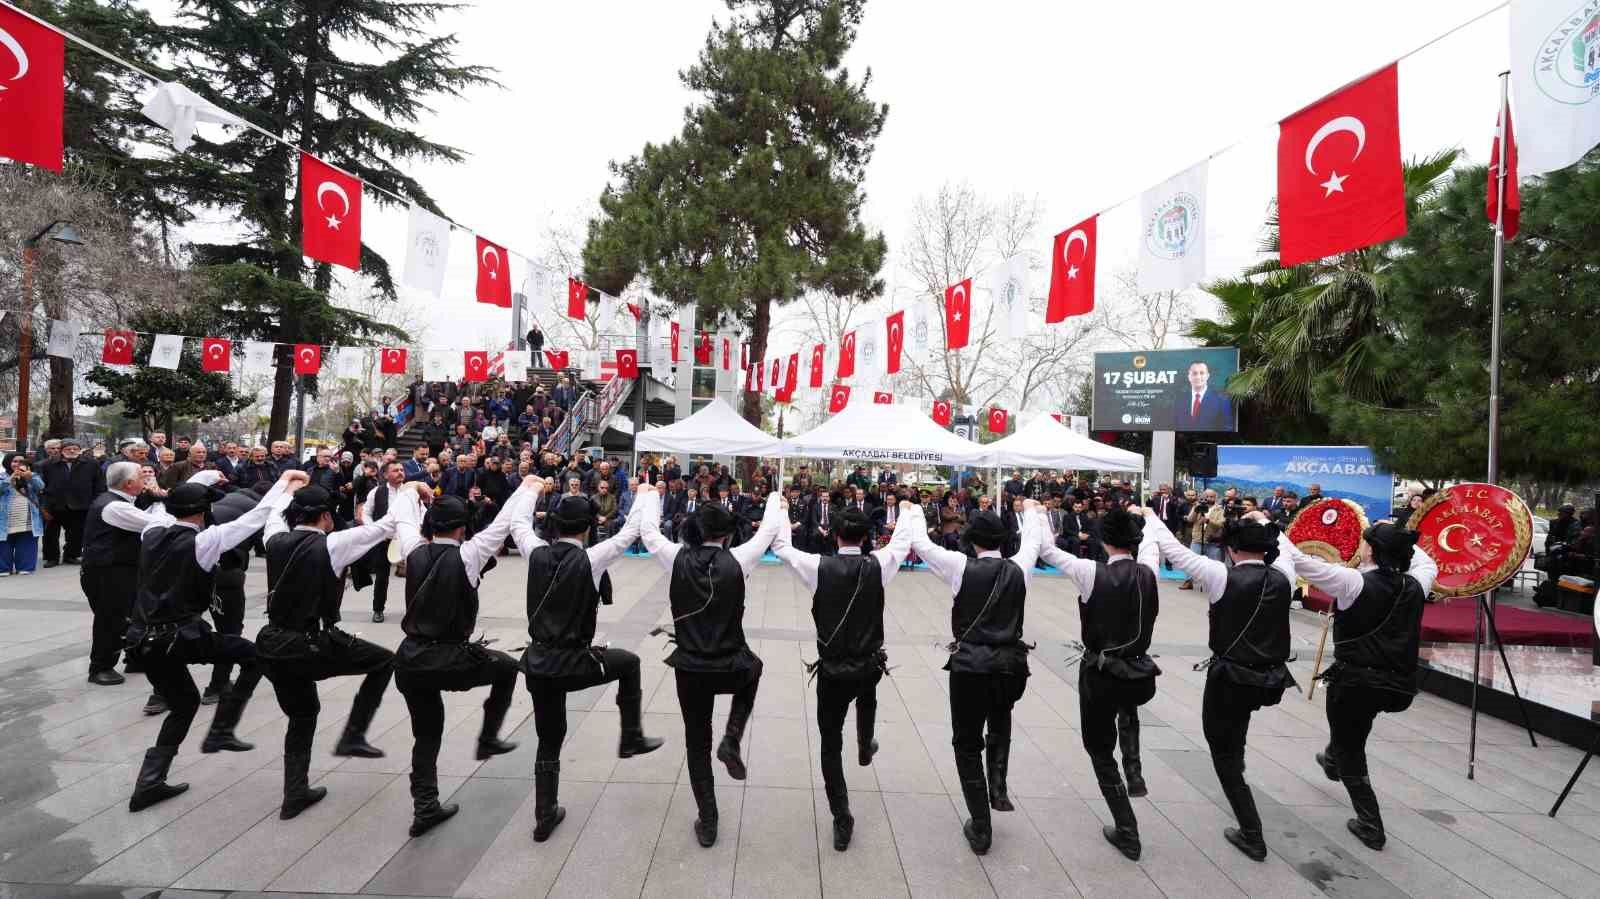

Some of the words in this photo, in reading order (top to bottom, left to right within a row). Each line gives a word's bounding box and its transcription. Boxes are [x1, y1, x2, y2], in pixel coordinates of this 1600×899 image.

[1103, 371, 1120, 385] 17
[1123, 370, 1178, 388] ŞUBAT
[842, 449, 890, 459] AKÇAABAT
[891, 450, 943, 462] BELEDİYESİ
[1285, 461, 1377, 477] AKÇAABAT
